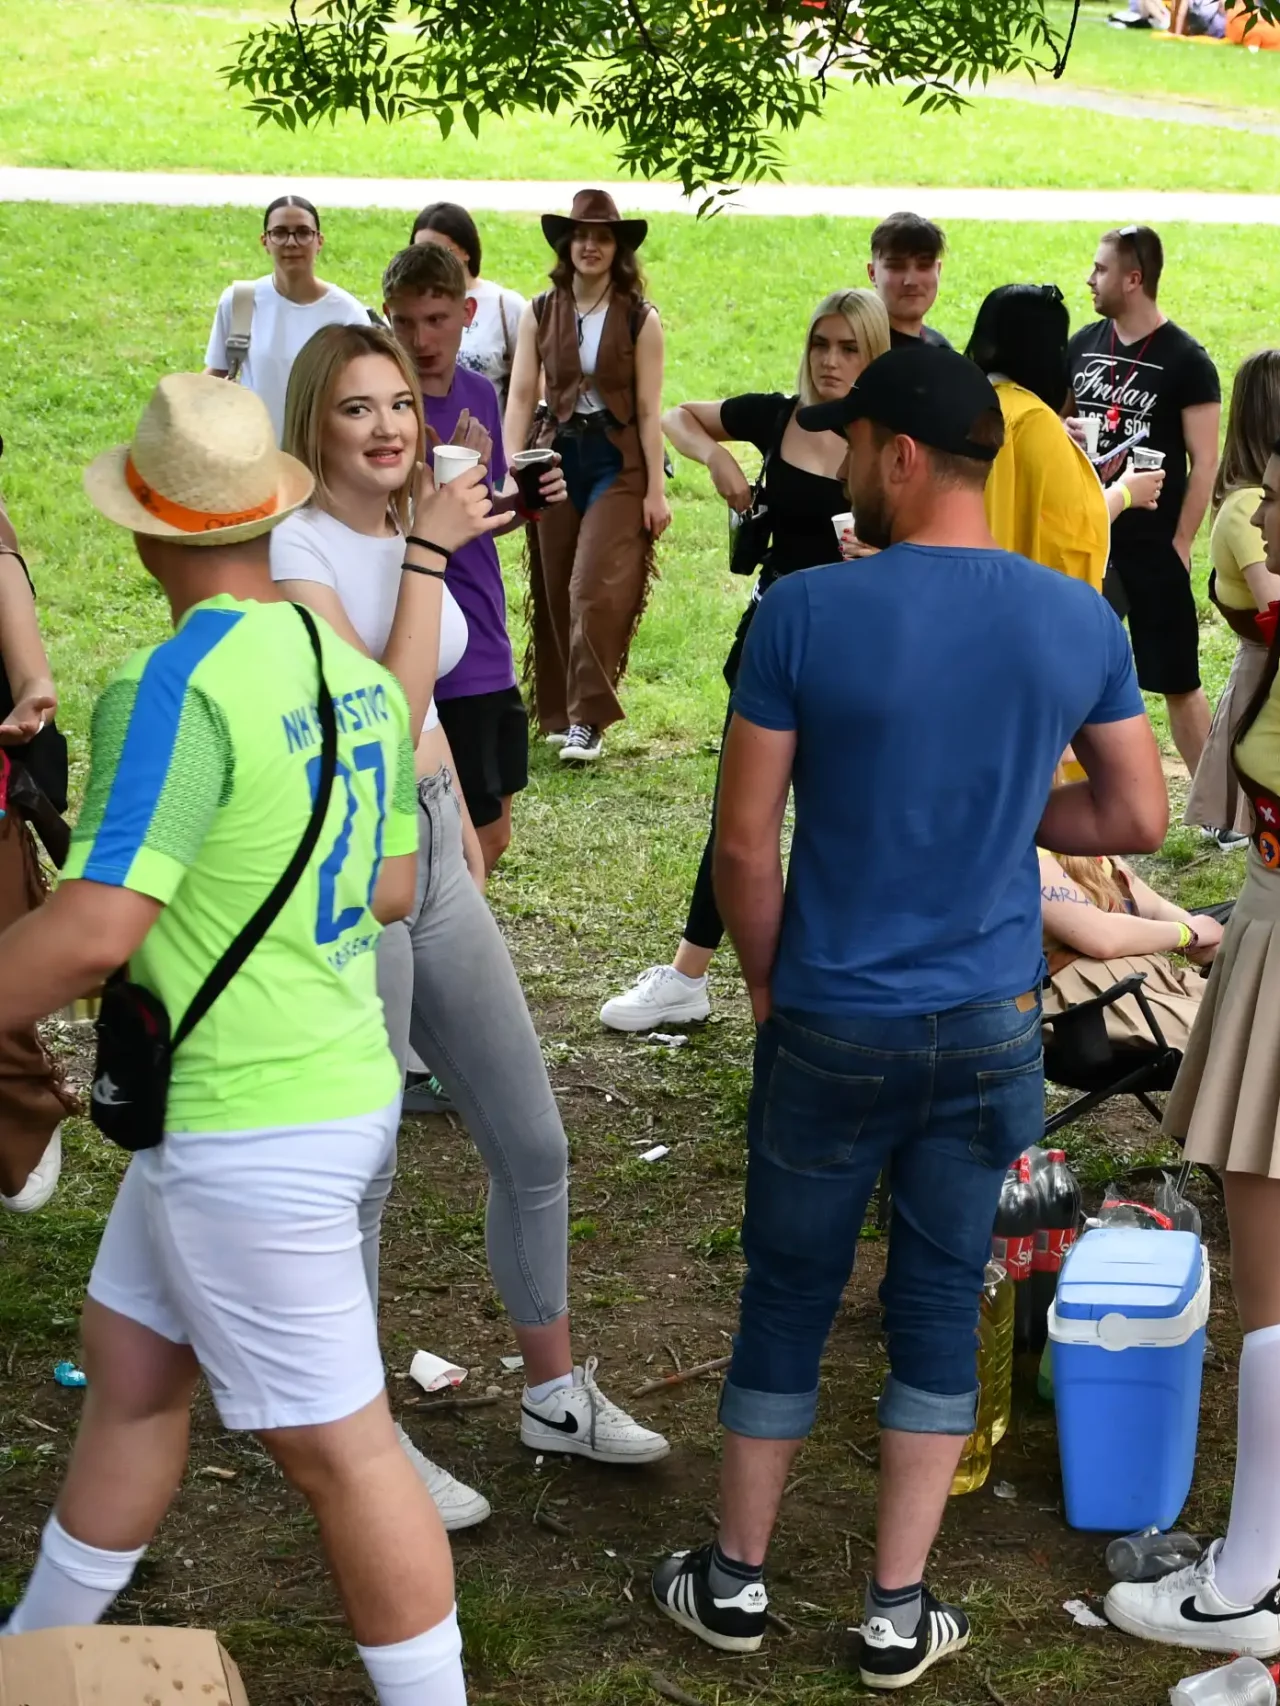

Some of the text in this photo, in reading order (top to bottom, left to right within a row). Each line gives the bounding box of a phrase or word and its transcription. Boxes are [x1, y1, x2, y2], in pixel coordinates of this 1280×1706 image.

[1073, 359, 1158, 420] Friday
[305, 740, 386, 946] 27
[1040, 885, 1091, 906] KARL
[1019, 1247, 1034, 1266] SK
